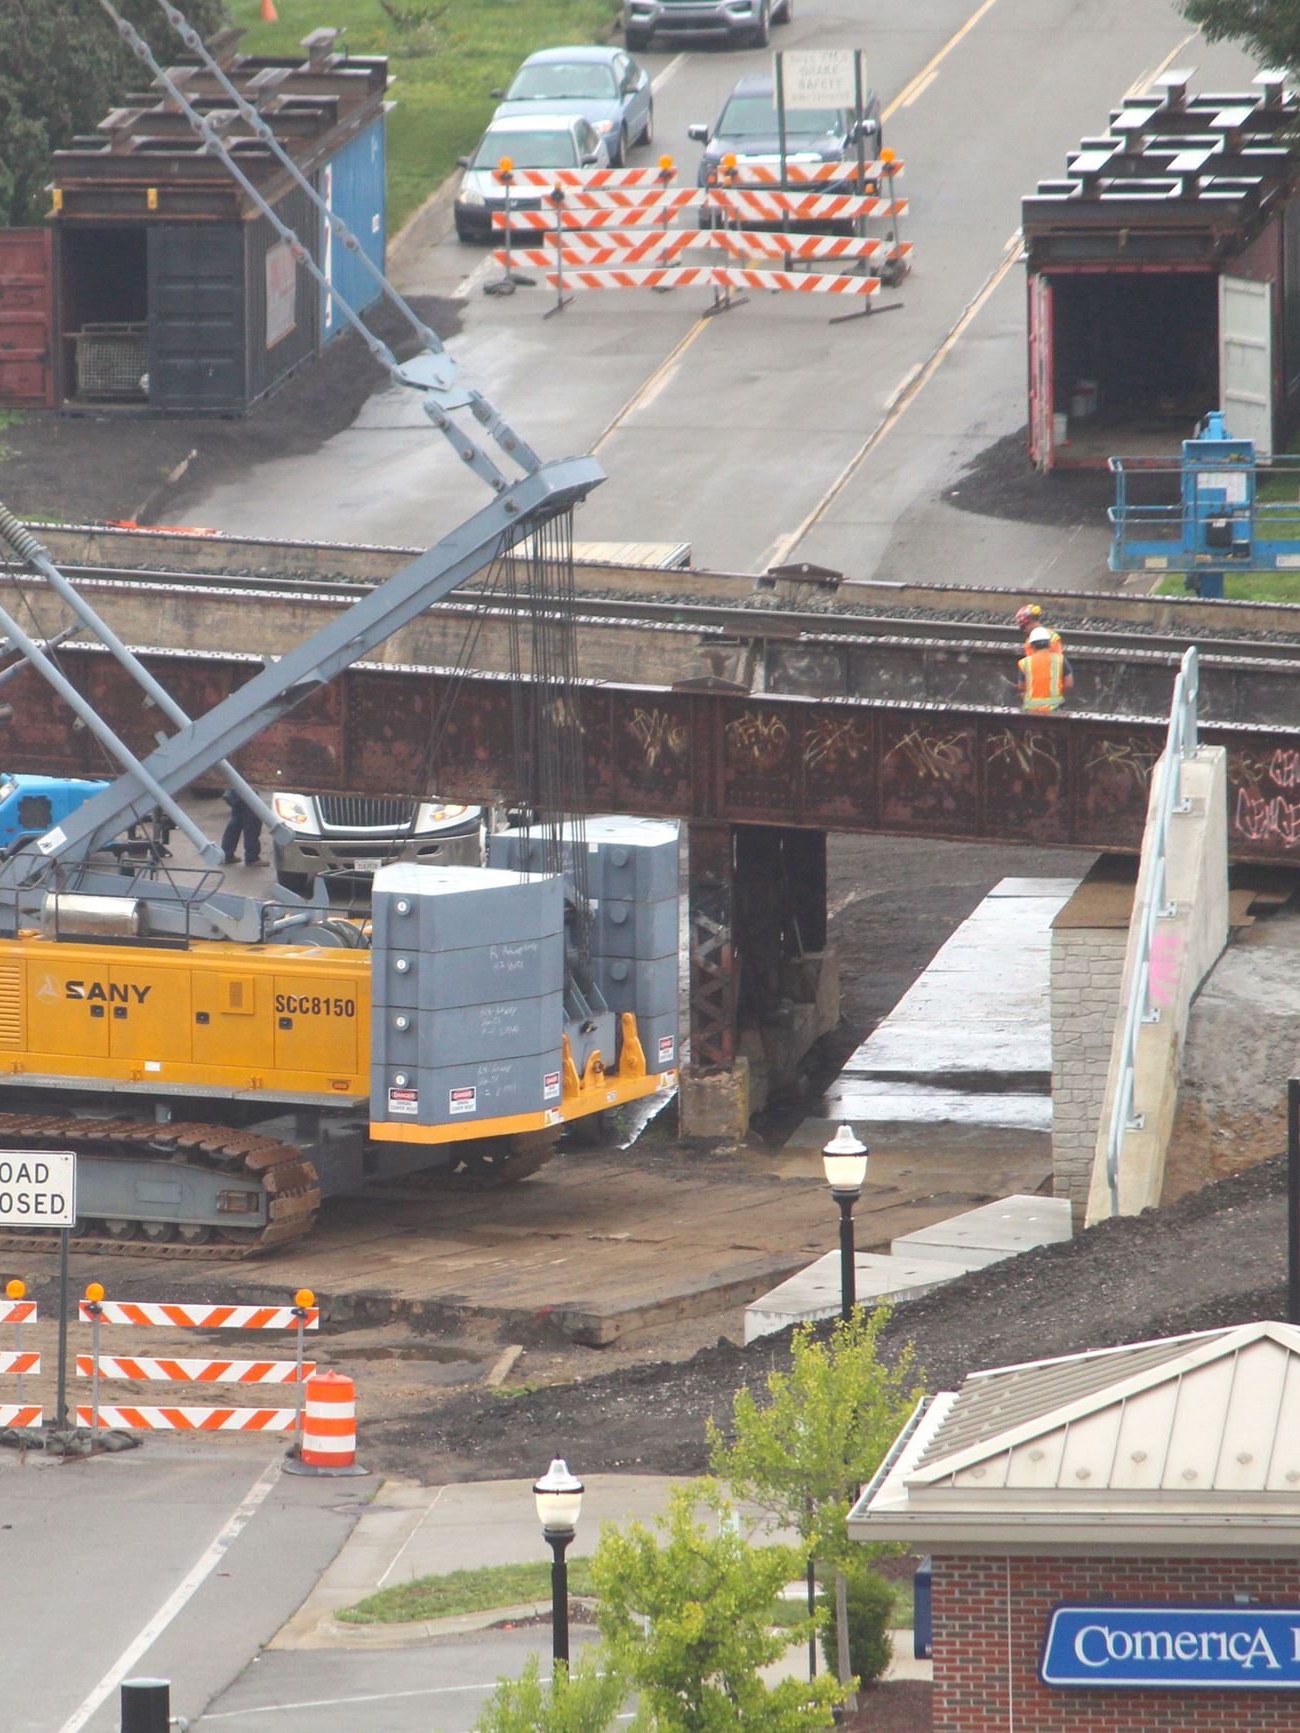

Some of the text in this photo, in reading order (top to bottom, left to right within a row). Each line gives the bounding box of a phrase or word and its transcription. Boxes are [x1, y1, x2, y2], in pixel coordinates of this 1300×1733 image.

[65, 980, 151, 1003] SANY
[275, 994, 355, 1017] SCC8150
[391, 1091, 417, 1099] DANGER
